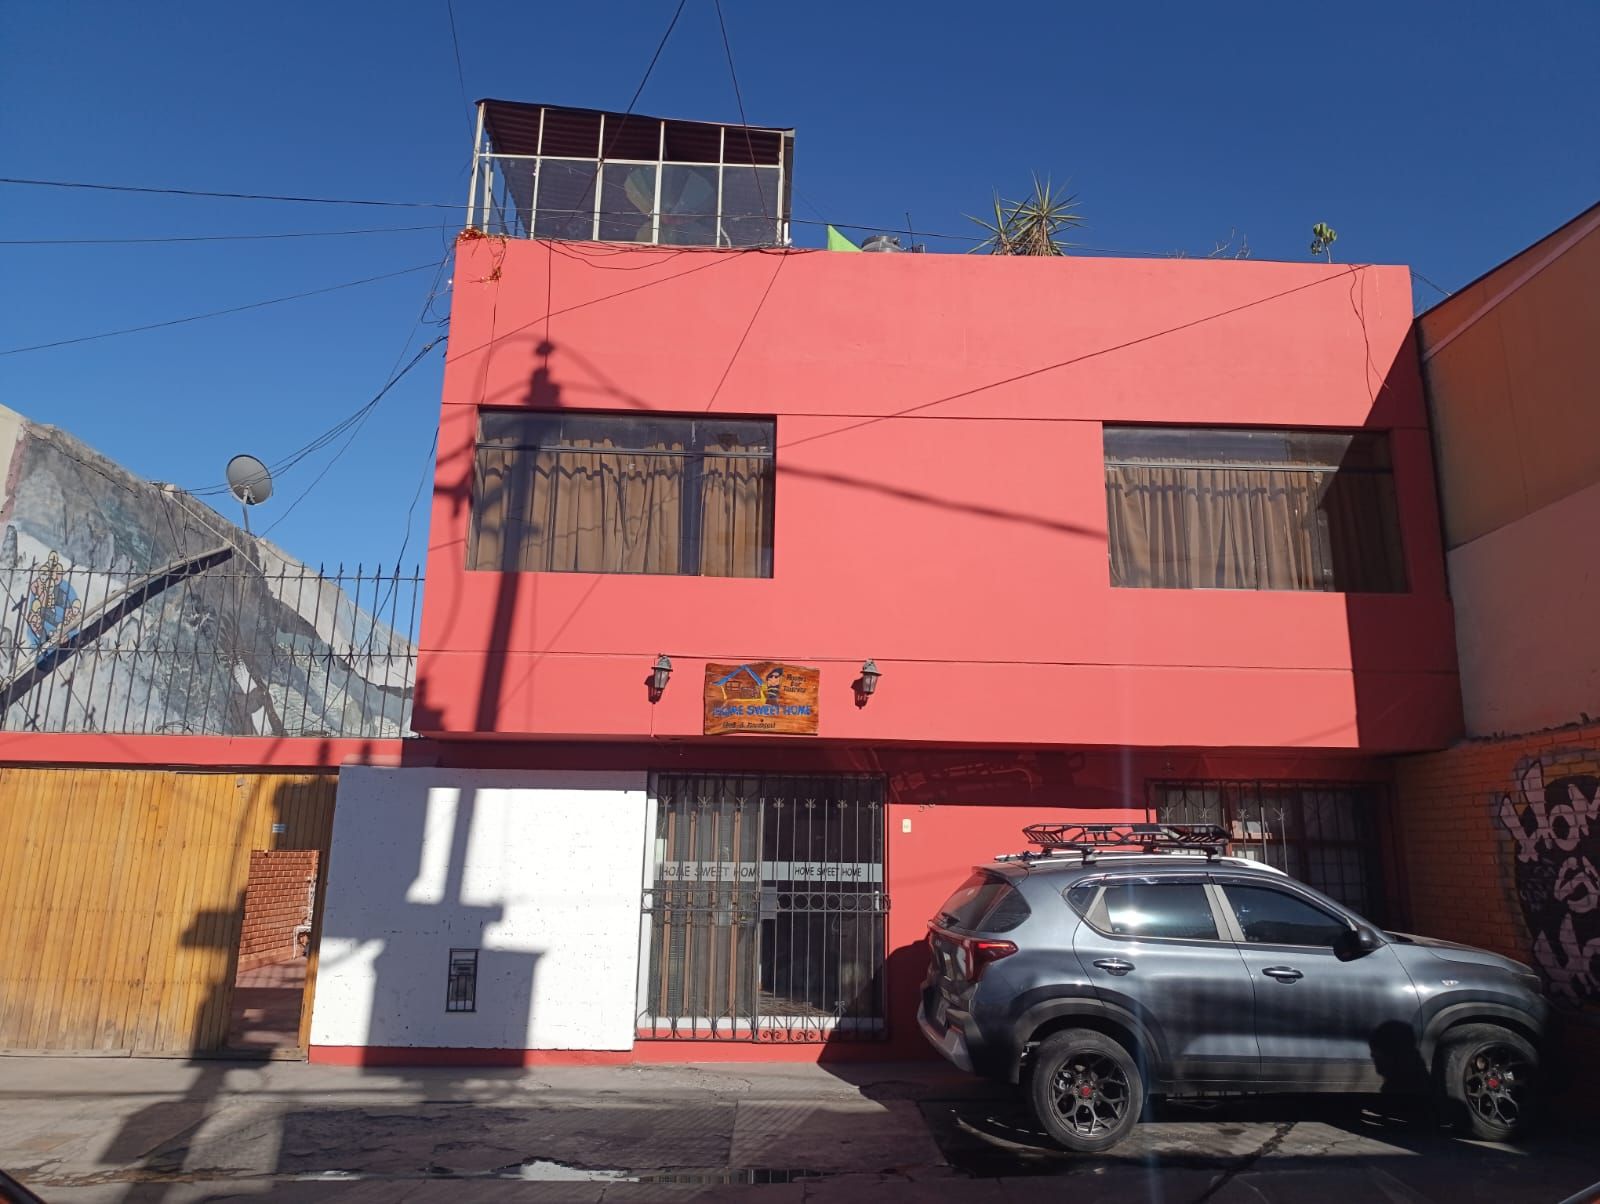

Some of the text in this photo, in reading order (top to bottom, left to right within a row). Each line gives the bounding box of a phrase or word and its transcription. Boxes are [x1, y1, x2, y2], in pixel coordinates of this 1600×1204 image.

[746, 704, 780, 716] SWEET
[783, 704, 812, 716] HOME
[663, 866, 691, 877] HOME
[694, 866, 730, 877] SWEET
[794, 865, 862, 877] HOME SWEET HOME
